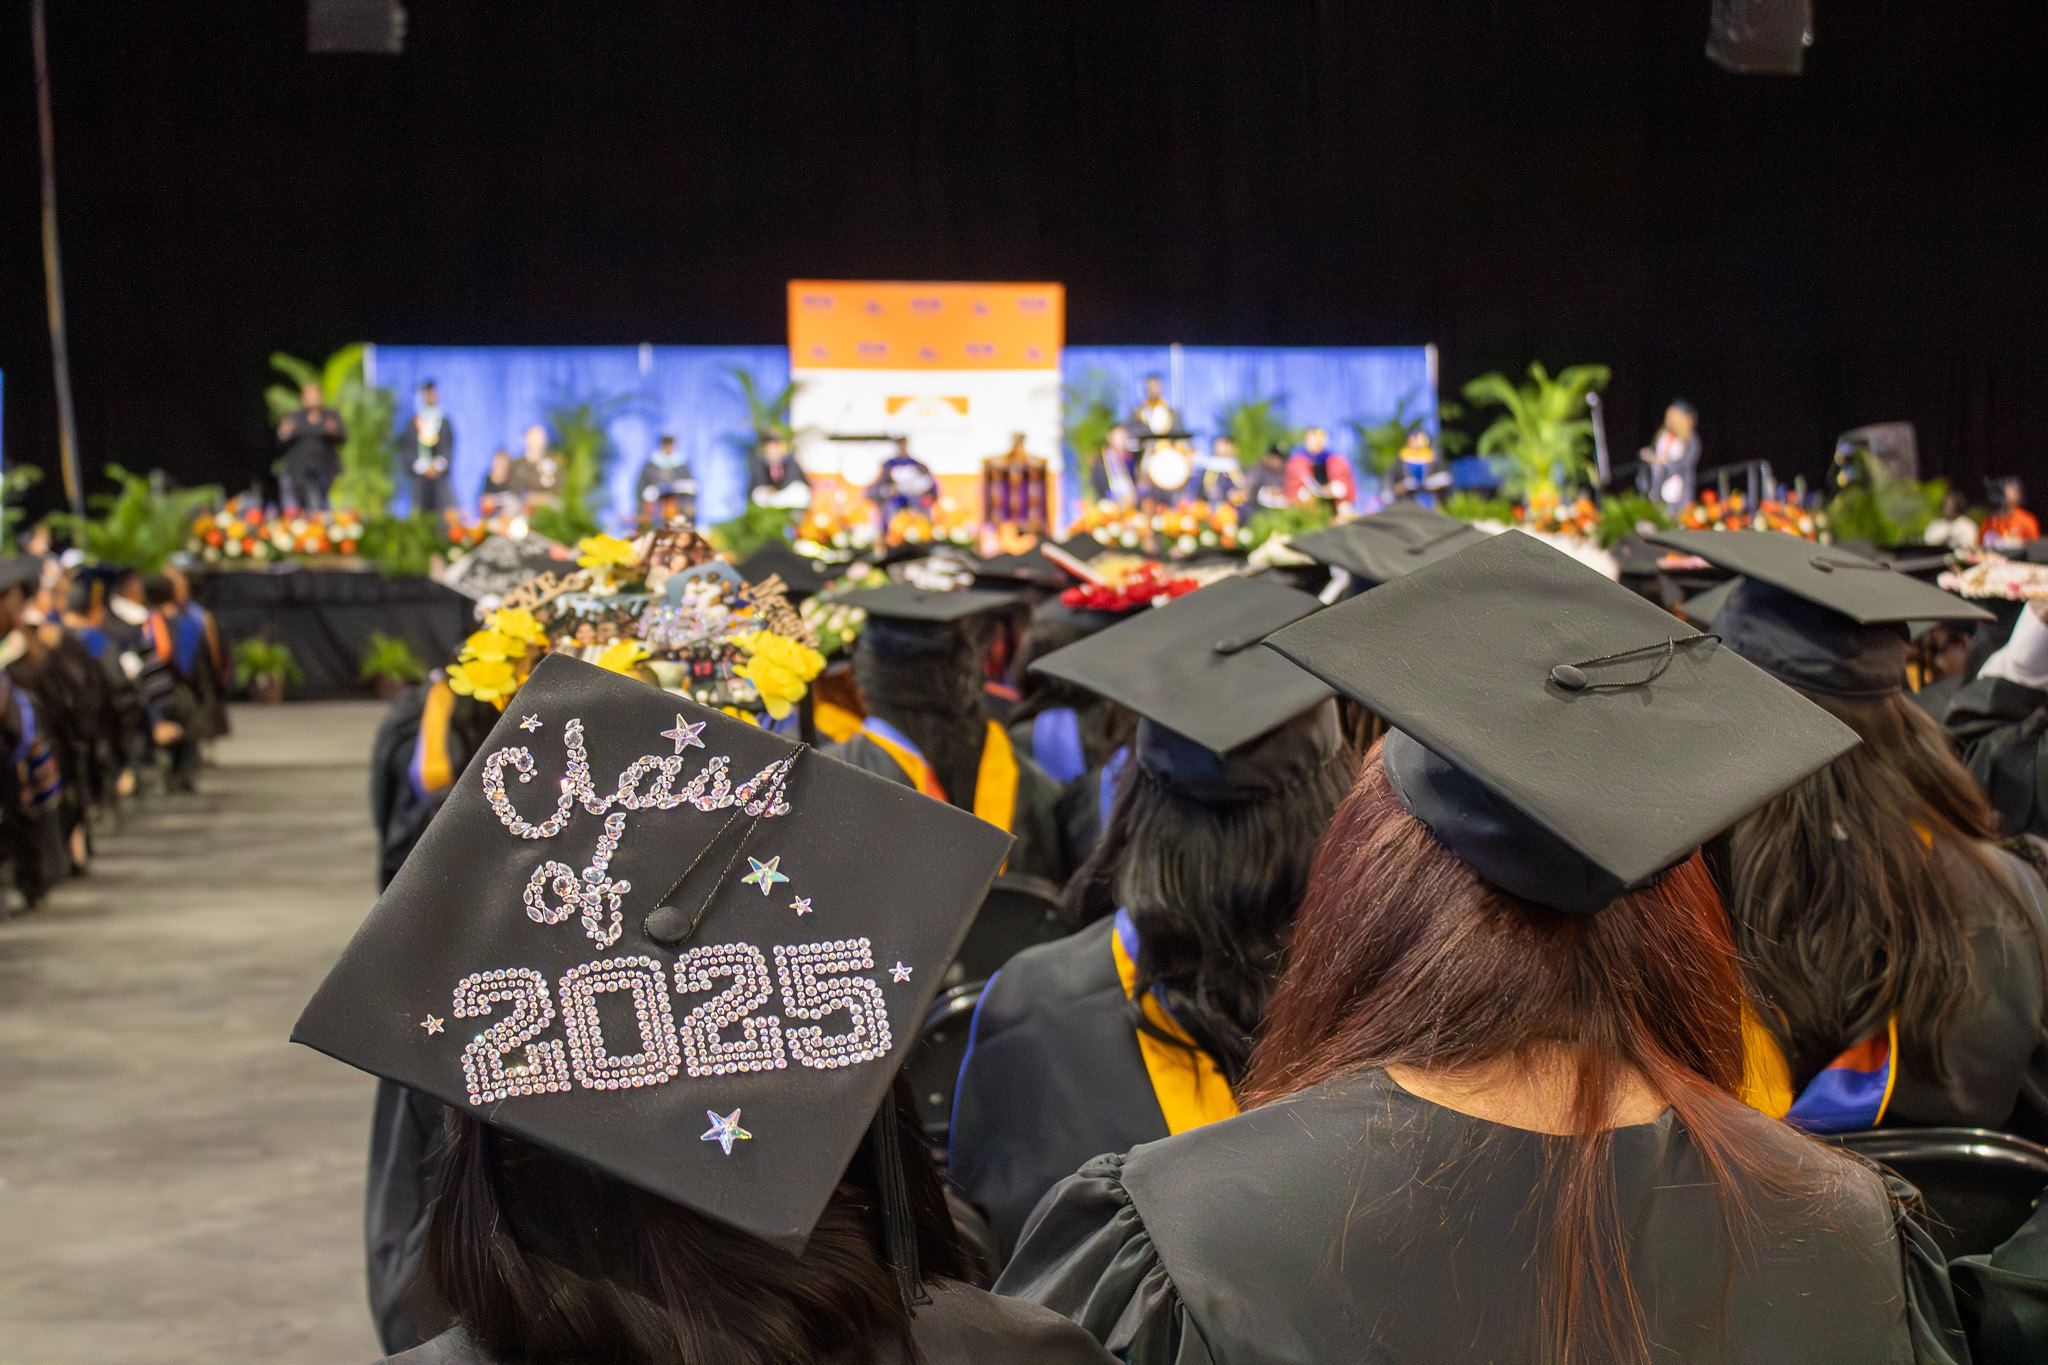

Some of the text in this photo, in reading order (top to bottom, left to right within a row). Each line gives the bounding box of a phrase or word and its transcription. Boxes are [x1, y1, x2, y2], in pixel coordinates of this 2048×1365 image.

[482, 718, 793, 839] Class
[523, 812, 631, 950] of
[452, 937, 893, 1105] 2025
